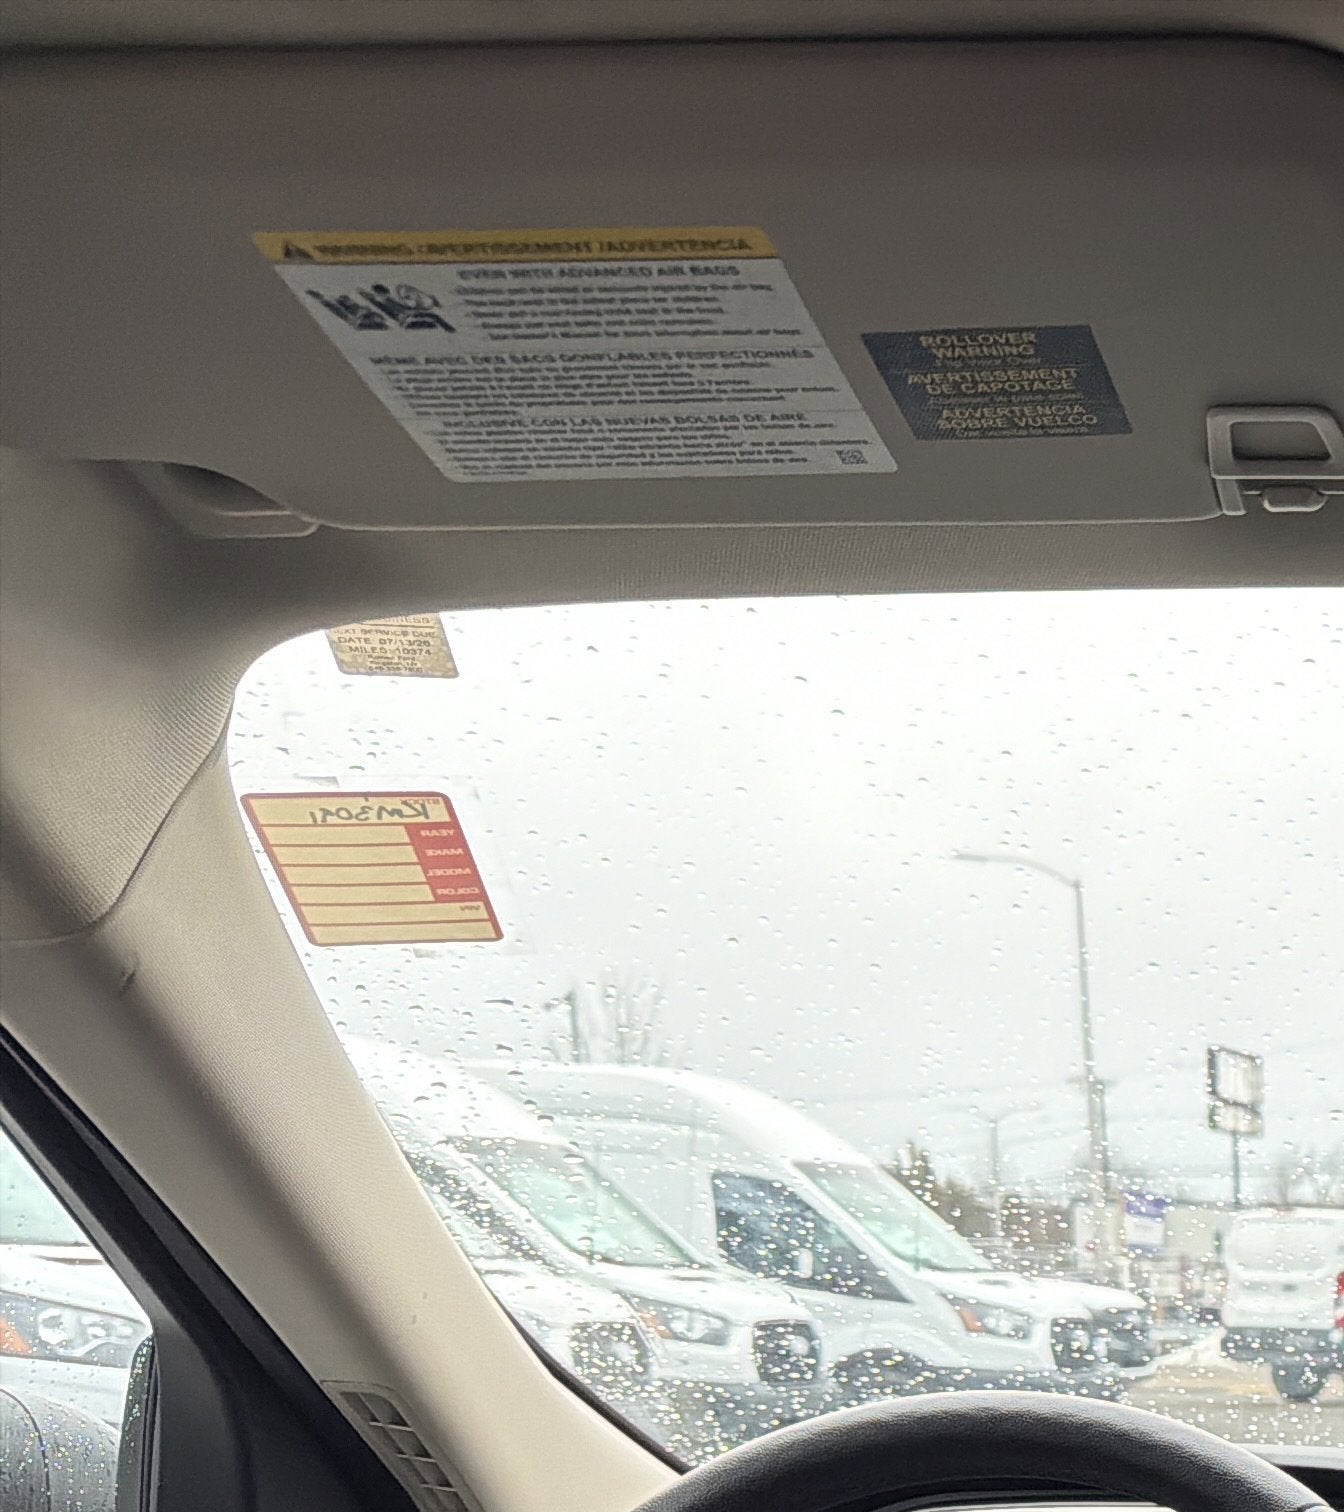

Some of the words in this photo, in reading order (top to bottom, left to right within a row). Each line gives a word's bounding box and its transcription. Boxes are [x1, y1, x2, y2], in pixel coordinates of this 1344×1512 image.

[558, 266, 652, 279] ADVANCED
[656, 266, 688, 277] AIR
[689, 265, 741, 277] BAGS
[919, 331, 1037, 347] ROLLOVER
[470, 354, 508, 365] DES
[509, 353, 556, 365] SACS
[558, 350, 673, 364] GONFLABLES
[674, 348, 816, 362] PERFECTIONNÉS
[931, 344, 1037, 359] WARNING
[907, 367, 1080, 385] AVERTISSEMENT
[925, 384, 956, 396] DE
[960, 377, 1076, 394] CAPOTAGE
[530, 416, 568, 428] CON
[604, 415, 672, 427] NUEVAS
[673, 413, 741, 426] BOLSAS
[743, 412, 767, 424] DE
[770, 411, 808, 423] AIRE
[941, 404, 1087, 421] ADVERTENCIA
[936, 417, 1010, 430] SOBRE
[1014, 413, 1099, 429] VUELCO
[412, 629, 437, 639] DUE
[395, 647, 433, 656] 10374
